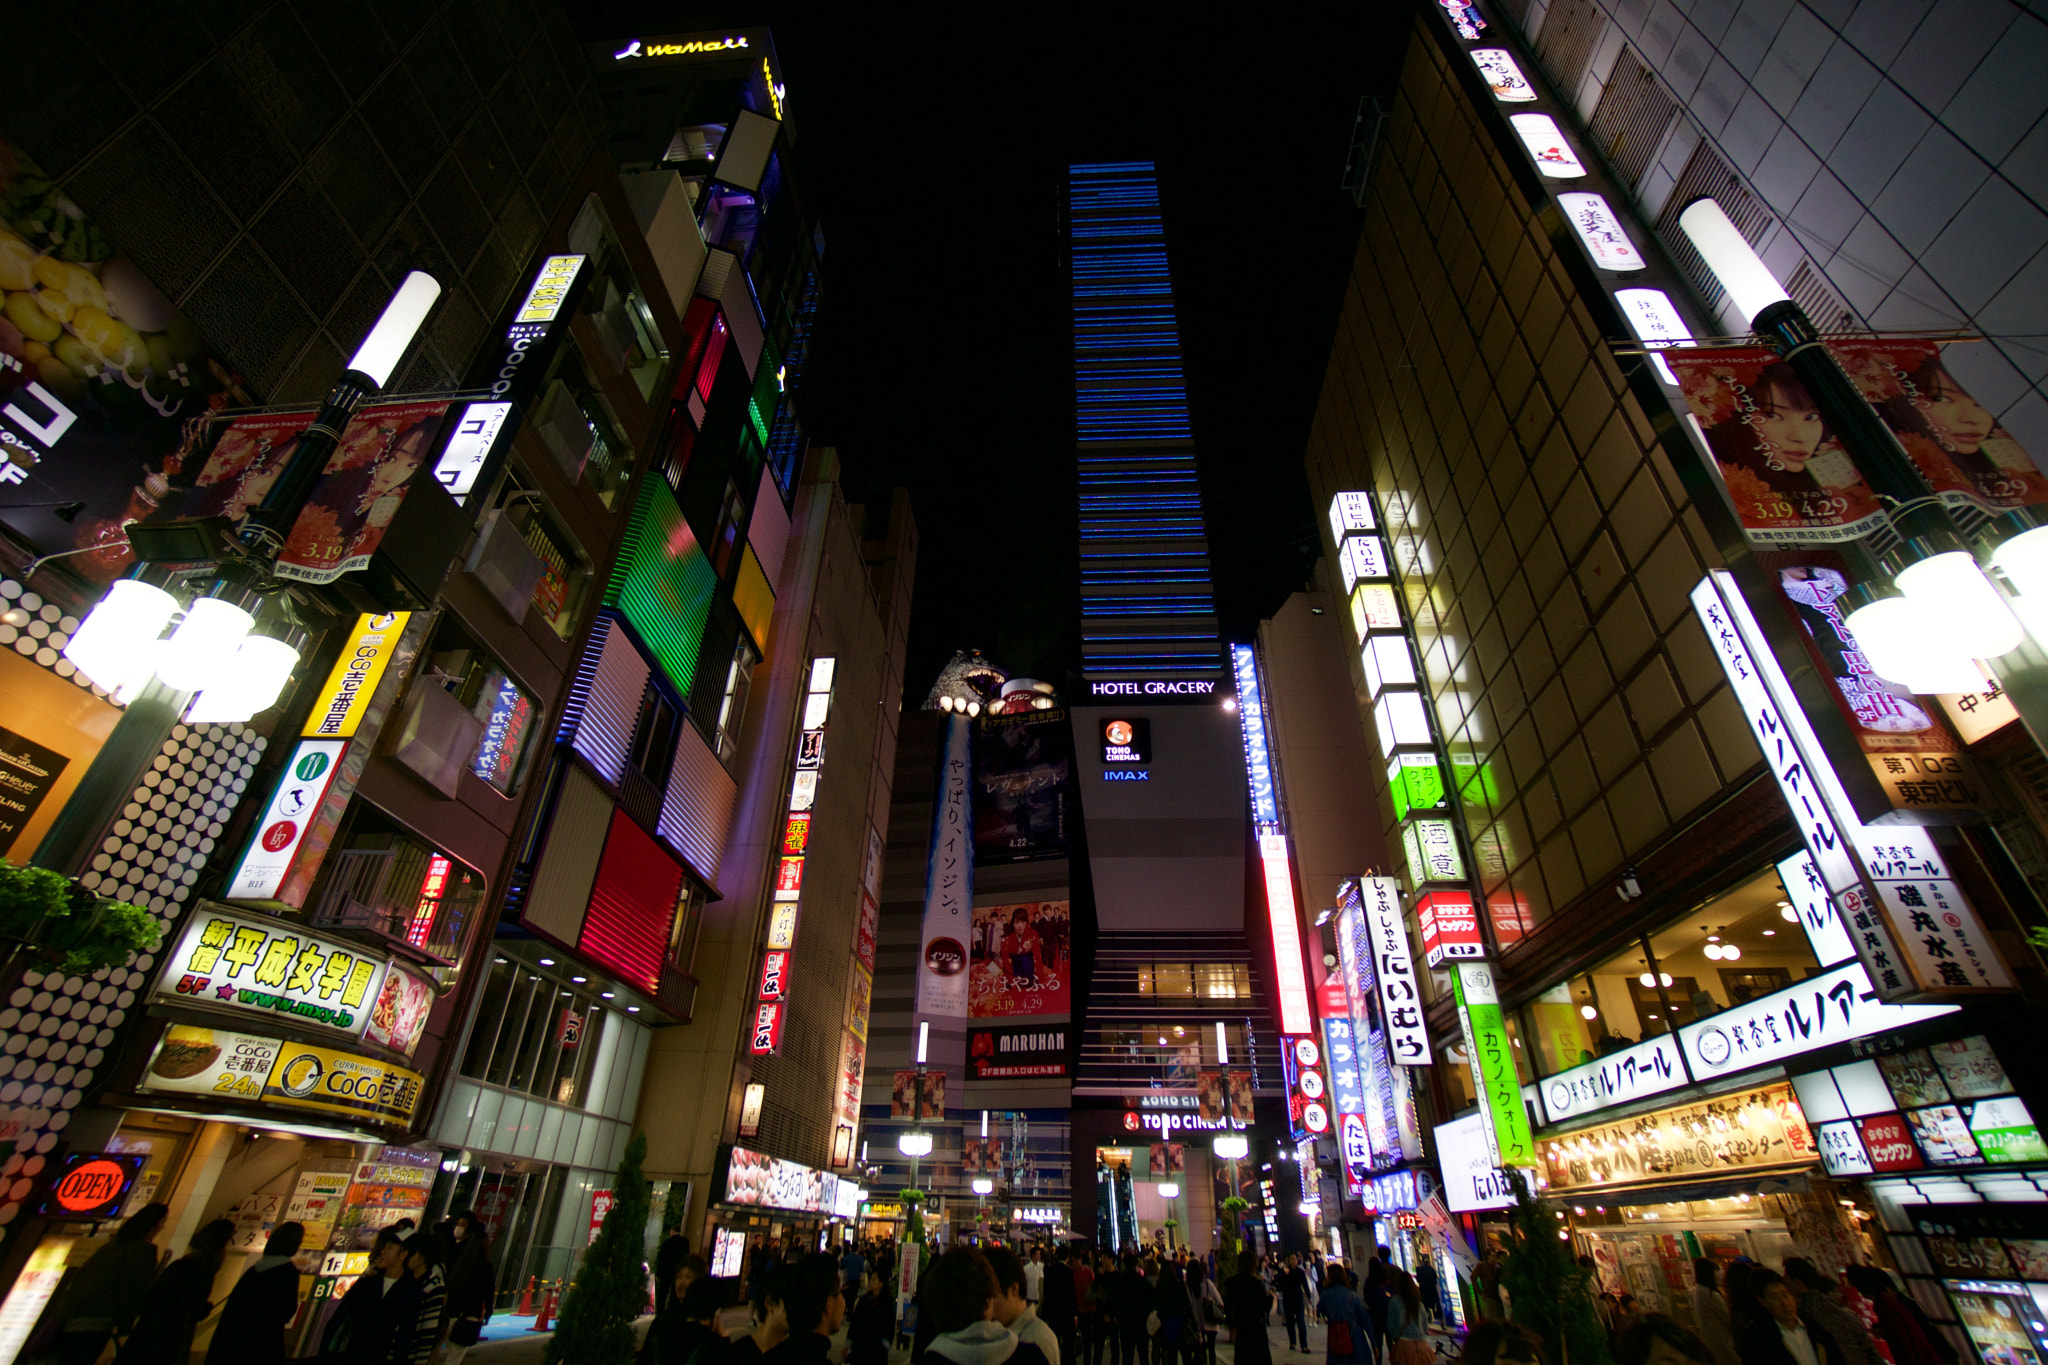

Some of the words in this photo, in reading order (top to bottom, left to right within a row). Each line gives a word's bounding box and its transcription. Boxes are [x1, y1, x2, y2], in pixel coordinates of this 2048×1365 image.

[493, 338, 532, 394] COCO
[1724, 375, 1786, 473] ちはやふる
[1345, 494, 1368, 528] 川新ビル
[1752, 501, 1794, 519] 3.19
[1801, 497, 1849, 518] 4.29
[302, 542, 343, 561] 3.19
[1358, 538, 1378, 576] にいむら
[1237, 651, 1257, 696] 747
[1007, 693, 1031, 702] イソジン
[1092, 682, 1142, 695] HOTEL
[1145, 681, 1215, 694] GRACERY
[1858, 709, 1876, 722] 9F
[1106, 747, 1131, 755] TOHO
[1106, 754, 1141, 762] CINEMAS
[1244, 702, 1272, 816] カラオケランド
[1103, 771, 1149, 781] IMAX
[1883, 757, 1963, 774] 第103
[986, 772, 1061, 795] レヴェナント
[1759, 708, 1835, 857] ルノアール
[1895, 780, 1979, 806] 東京ビル
[786, 820, 808, 850] 麻雀
[942, 759, 965, 916] やっぱり、イソジン。
[1009, 838, 1027, 848] 4.22
[1873, 845, 1917, 860] 喫茶室
[1870, 860, 1940, 878] ルノアール
[1372, 878, 1399, 951] しゃぶしゃぶ
[1894, 884, 1972, 987] 磯丸水産
[187, 918, 234, 976] 新宿
[930, 950, 962, 963] イソジン
[1852, 912, 1902, 990] 磯丸水産
[223, 926, 376, 1009] 平成女学園
[176, 975, 211, 996] 5F
[976, 973, 1062, 994] ちはやふる
[238, 988, 355, 1029] www.mxy.jp
[995, 1000, 1015, 1012] 3.19
[1021, 998, 1043, 1010] 4.29
[1382, 954, 1425, 1058] にいむら
[235, 1037, 254, 1046] CURRY
[255, 1040, 278, 1049] HOUSE
[1000, 1032, 1066, 1053] MARUHAN
[1732, 1014, 1783, 1057] 喫茶室
[235, 1043, 272, 1058] CoCo
[224, 1055, 271, 1075] 壱番屋
[333, 1059, 359, 1074] CURRY
[359, 1064, 383, 1079] HOUSE
[1329, 1019, 1361, 1114] カラオケ
[1599, 1046, 1672, 1097] ルノアール
[213, 1072, 261, 1096] 24h
[1572, 1075, 1599, 1105] 喫茶室
[1824, 1150, 1869, 1171] ルノアール
[61, 1173, 122, 1201] OPEN
[299, 1179, 313, 1189] 5F
[1373, 1175, 1416, 1214] カラオケ
[325, 1257, 342, 1272] 1F
[314, 1278, 335, 1298] B1
